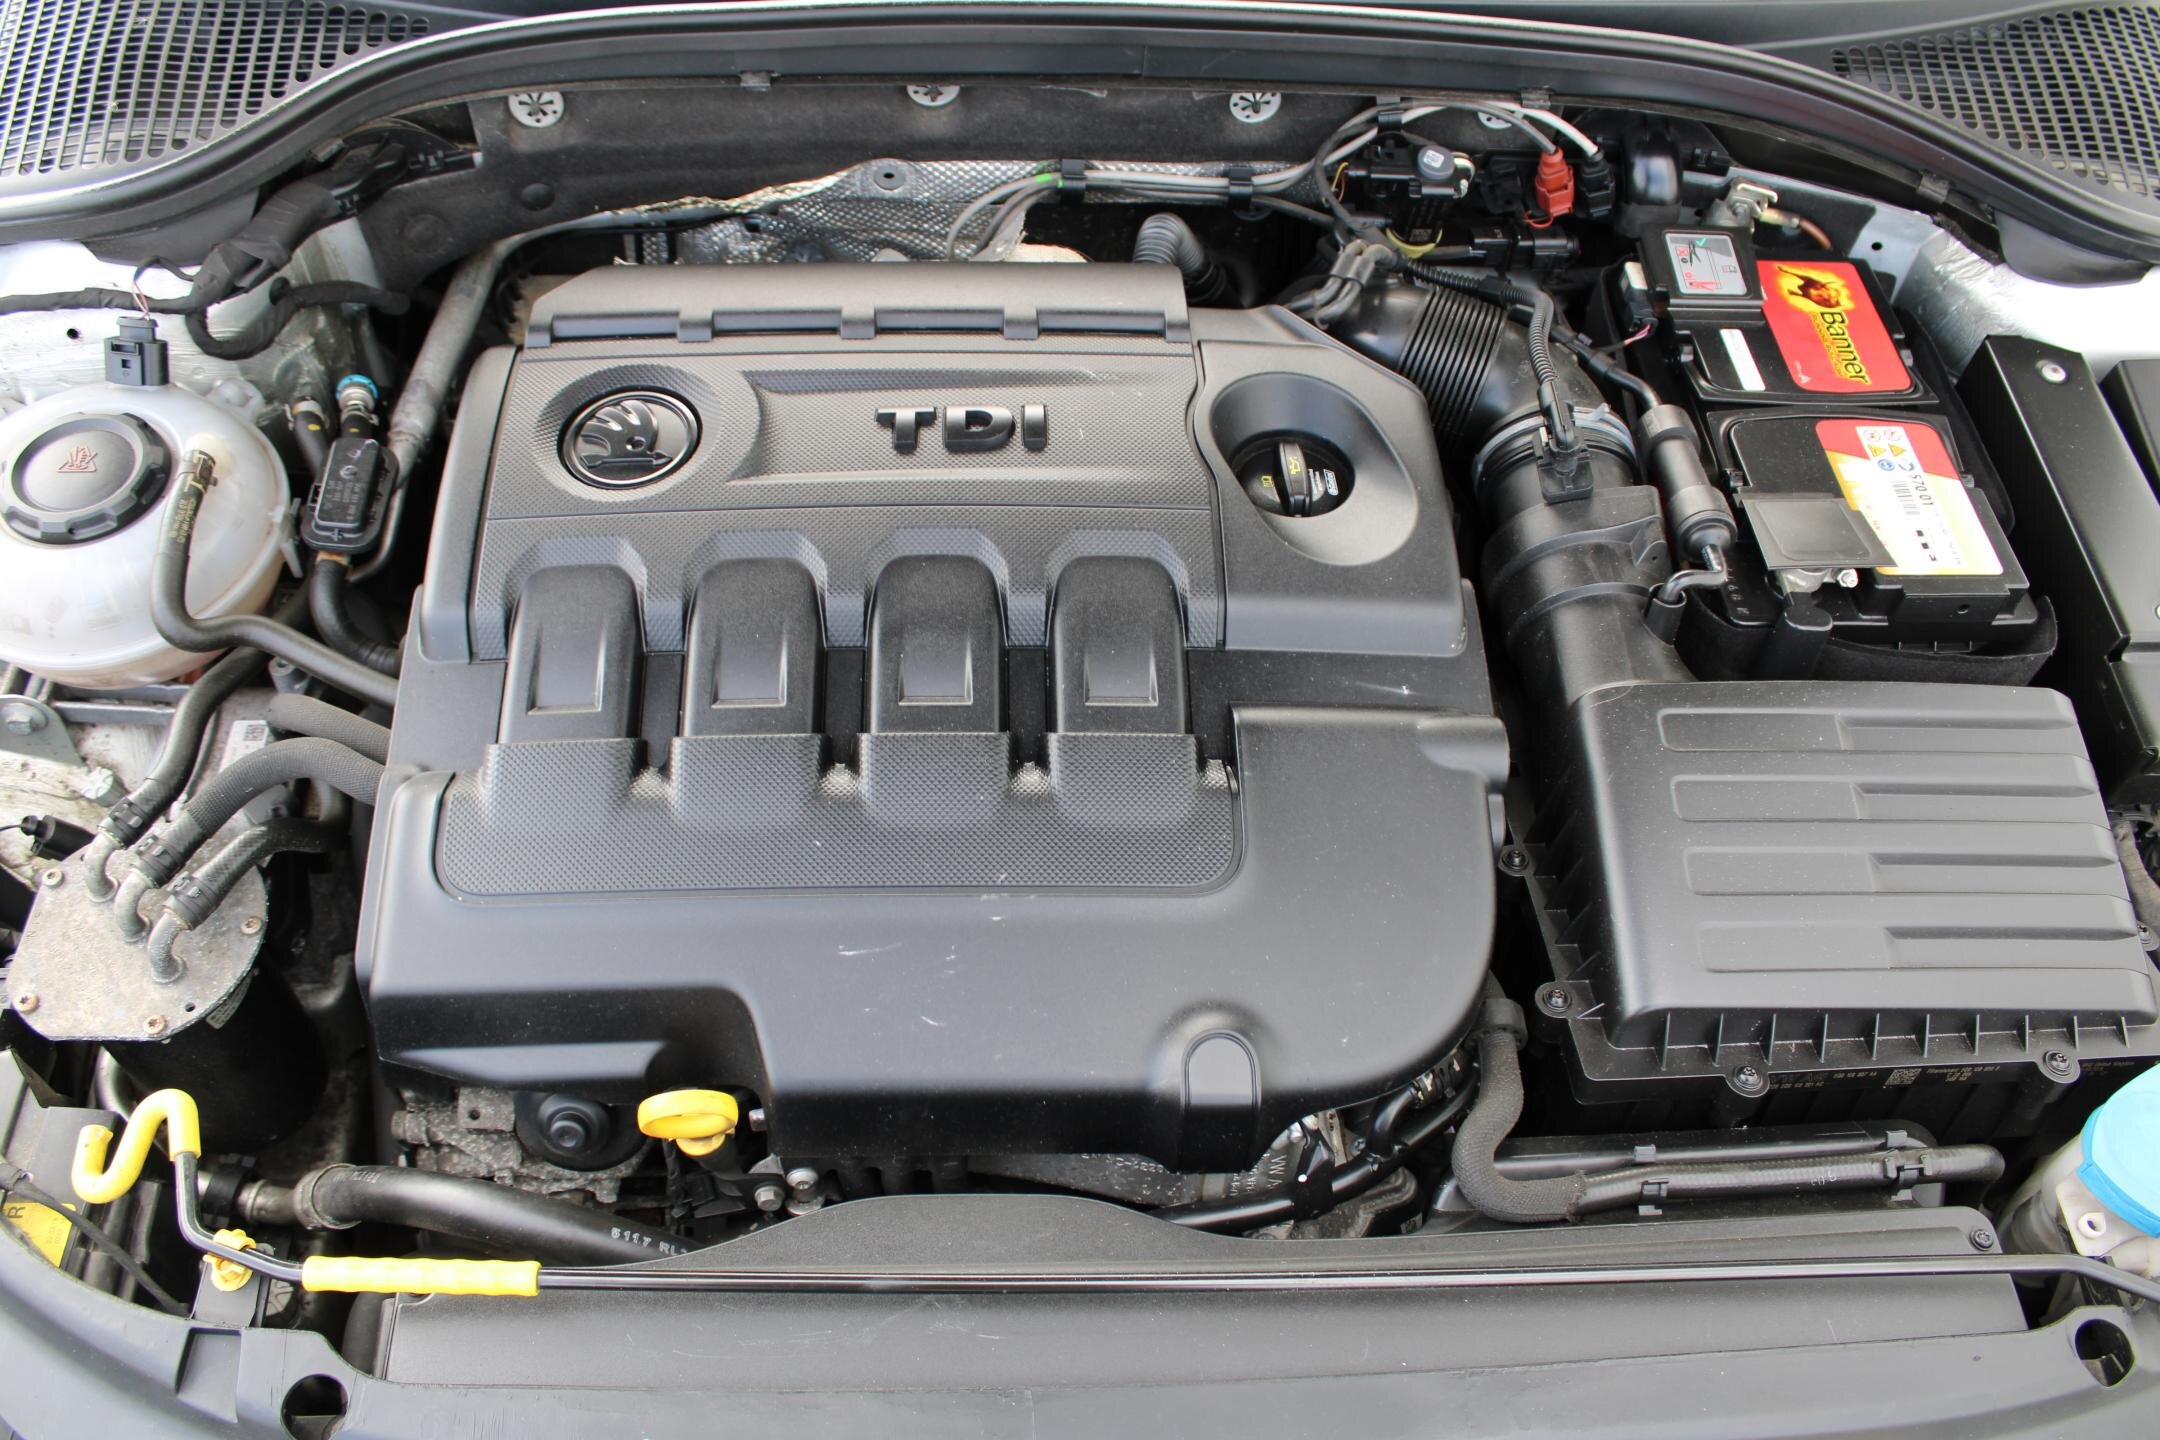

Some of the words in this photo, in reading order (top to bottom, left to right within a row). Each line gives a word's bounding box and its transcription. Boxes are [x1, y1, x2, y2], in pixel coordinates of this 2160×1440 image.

[1820, 311, 1868, 383] Banner
[874, 403, 1048, 453] TDI
[1908, 473, 1928, 492] 570
